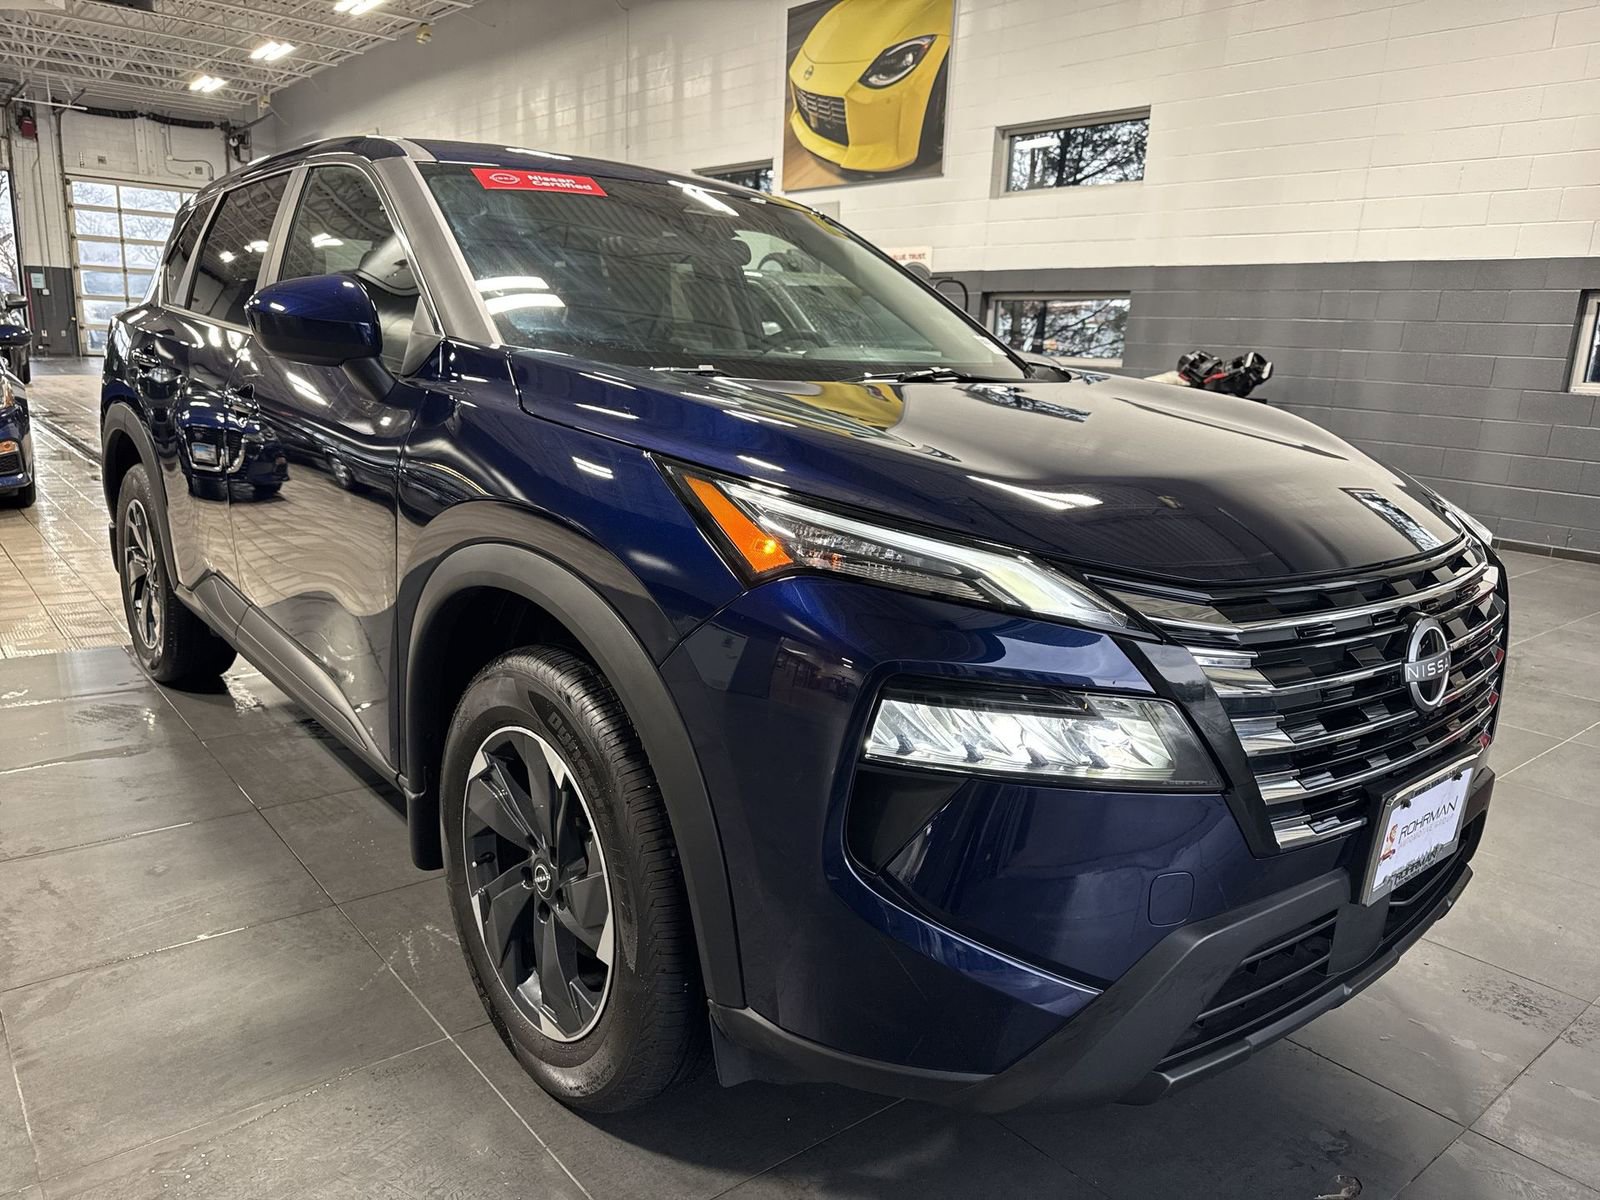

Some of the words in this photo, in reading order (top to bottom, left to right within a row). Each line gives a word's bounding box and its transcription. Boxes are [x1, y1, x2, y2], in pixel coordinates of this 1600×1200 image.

[527, 175, 575, 184] Nissan
[532, 180, 592, 190] Certified
[1407, 657, 1449, 680] NISSA
[1398, 795, 1459, 844] ROHRMAN
[1394, 845, 1437, 885] ROHRMAN
